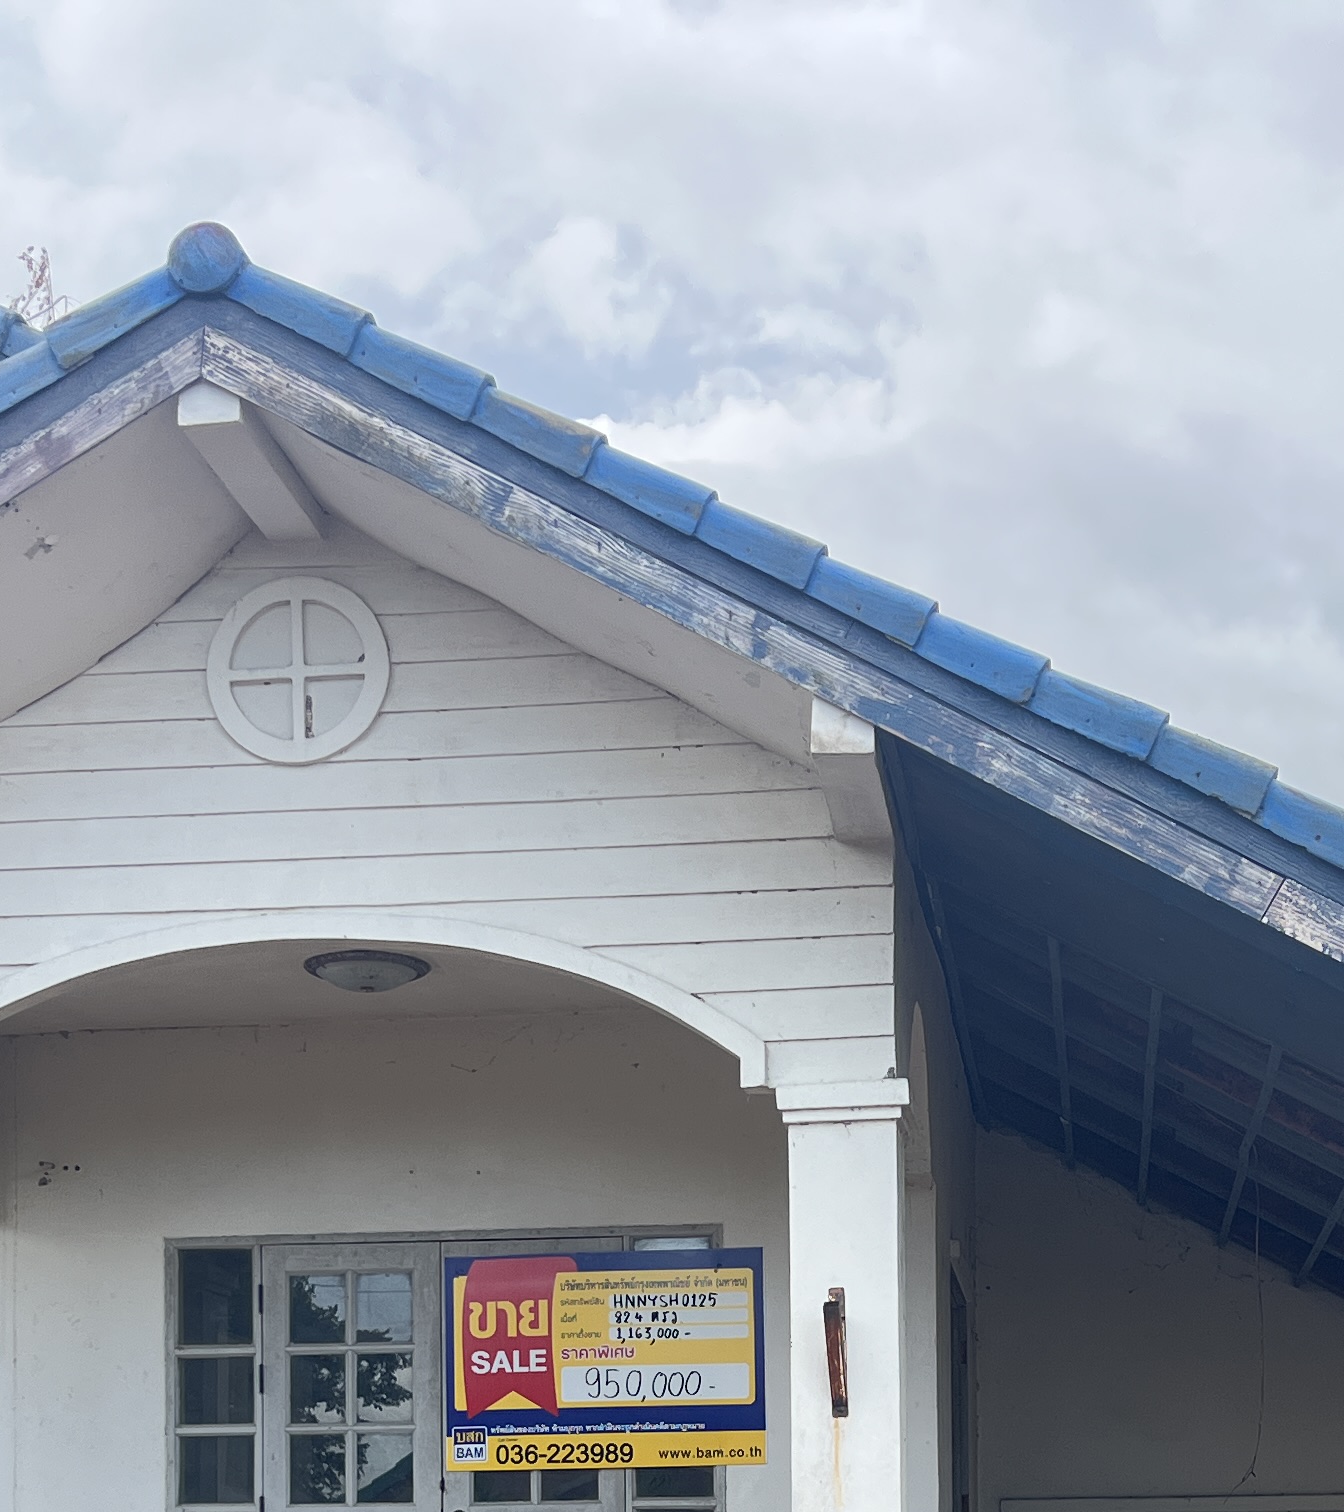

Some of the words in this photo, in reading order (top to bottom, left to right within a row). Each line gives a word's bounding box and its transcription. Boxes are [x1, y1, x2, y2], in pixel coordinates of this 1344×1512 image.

[468, 1298, 549, 1340] ขาย
[560, 1344, 636, 1361] ราคาพิเศษ
[470, 1349, 549, 1375] SALE
[455, 1430, 485, 1444] บสก
[455, 1447, 485, 1460] BAM
[495, 1442, 635, 1465] 036-223989
[658, 1445, 763, 1460] www.bam.co.th
